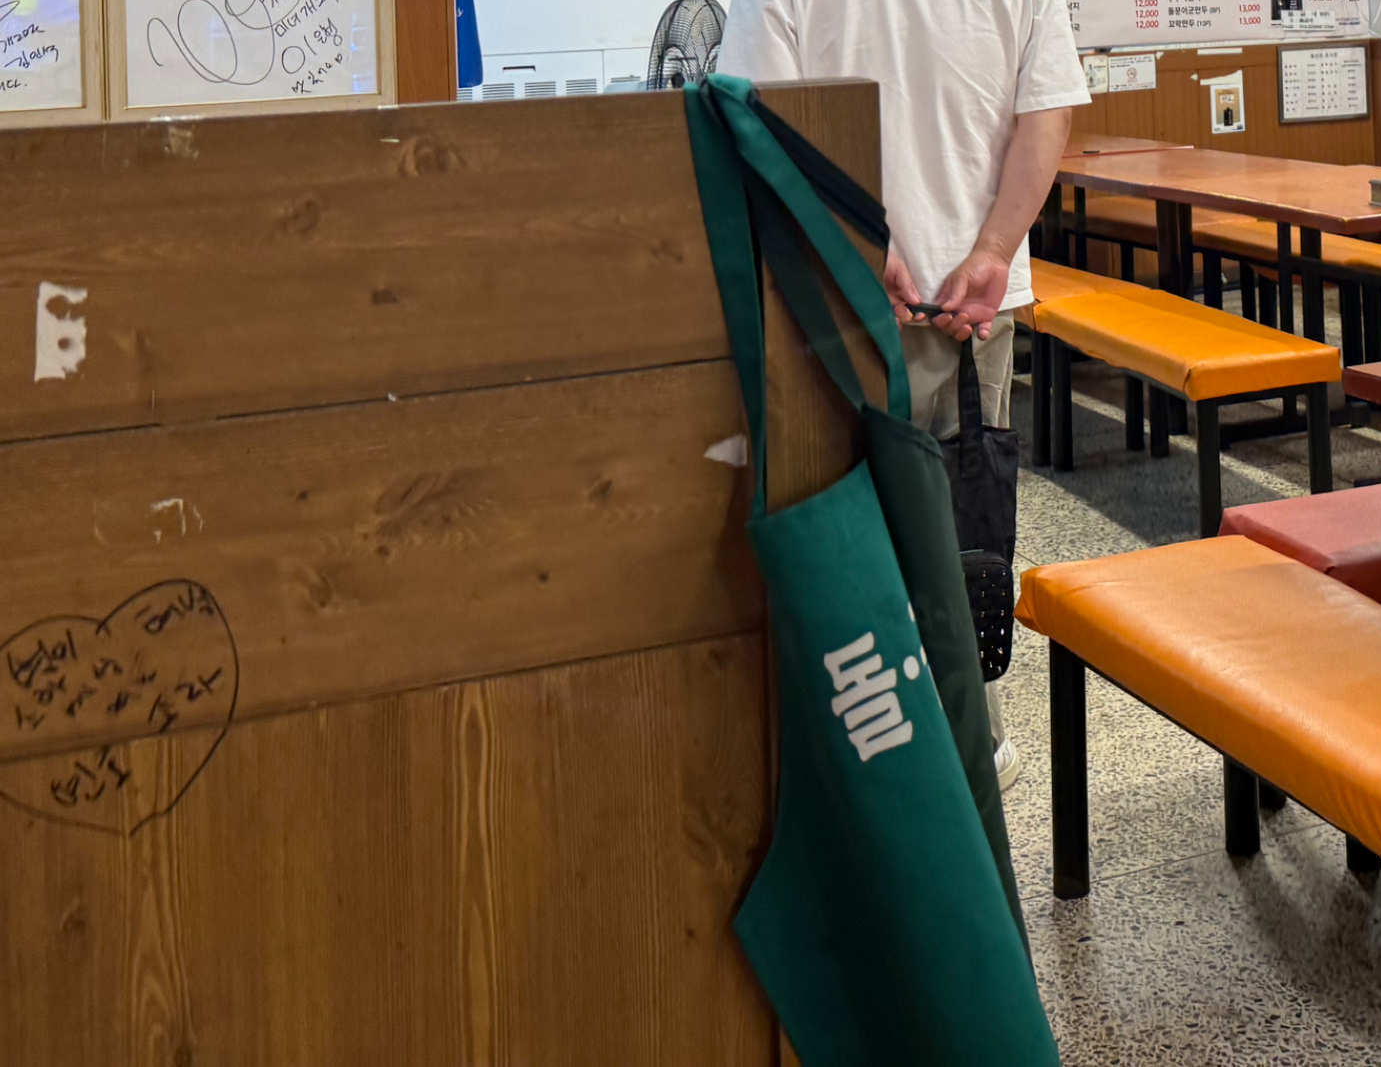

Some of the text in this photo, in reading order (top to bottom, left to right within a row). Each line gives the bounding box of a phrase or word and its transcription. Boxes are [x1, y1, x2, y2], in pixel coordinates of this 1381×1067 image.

[1135, 0, 1158, 8] 12,000
[1239, 4, 1260, 12] 13,000
[1135, 10, 1159, 19] 12,000
[1136, 21, 1159, 29] 12,000
[1239, 17, 1261, 25] 13,000
